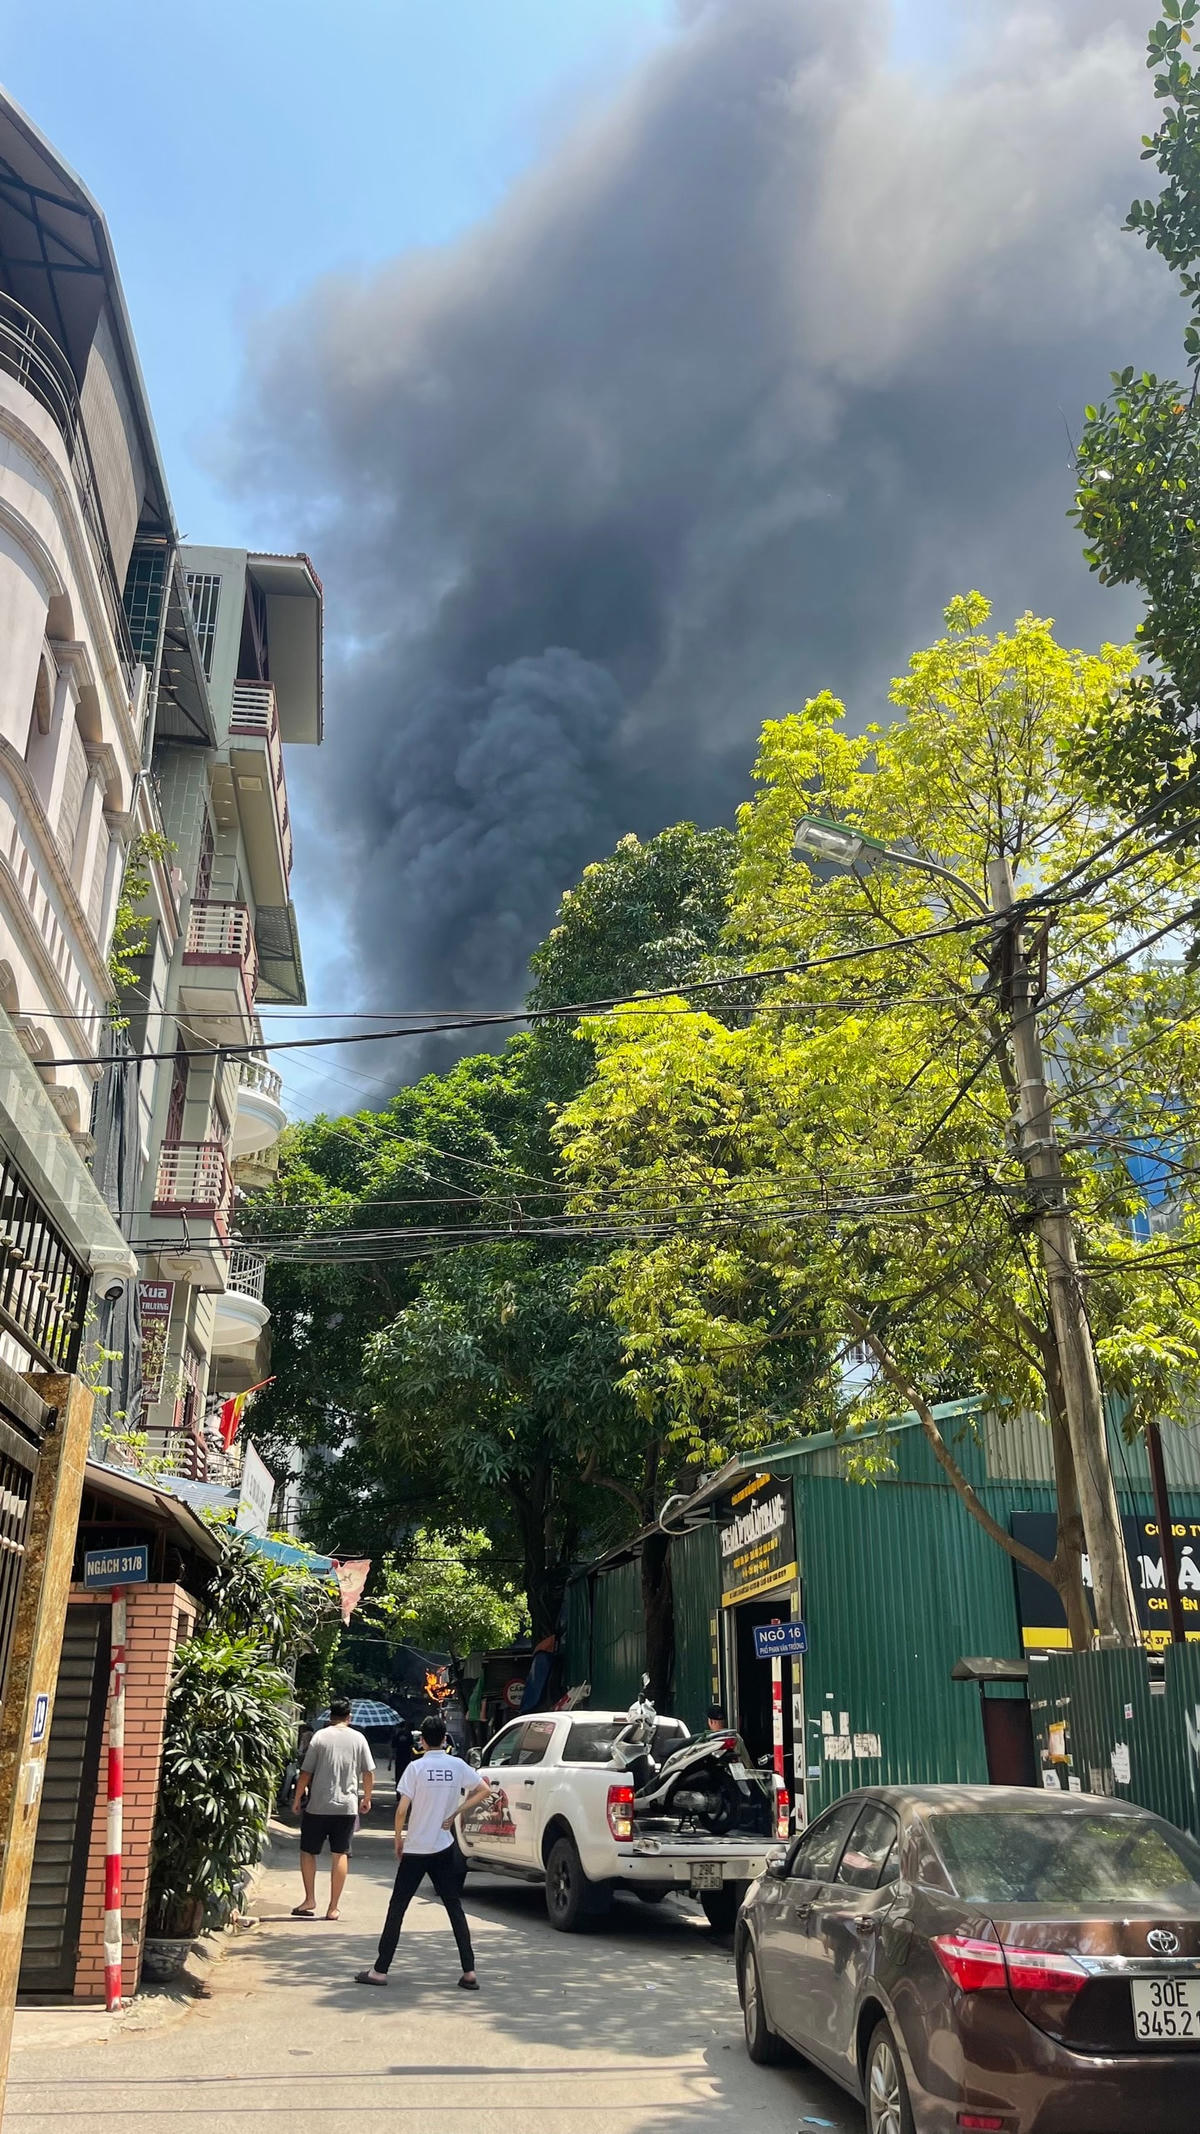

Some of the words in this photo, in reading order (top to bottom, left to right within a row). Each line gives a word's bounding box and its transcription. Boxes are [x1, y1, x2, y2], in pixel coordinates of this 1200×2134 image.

[121, 1556, 143, 1572] 31/8
[1148, 1597, 1199, 1611] CHÊN
[759, 1627, 786, 1643] NGÕ
[788, 1627, 801, 1639] 16
[1155, 1636, 1164, 1645] 37
[1149, 1981, 1189, 2008] 30E
